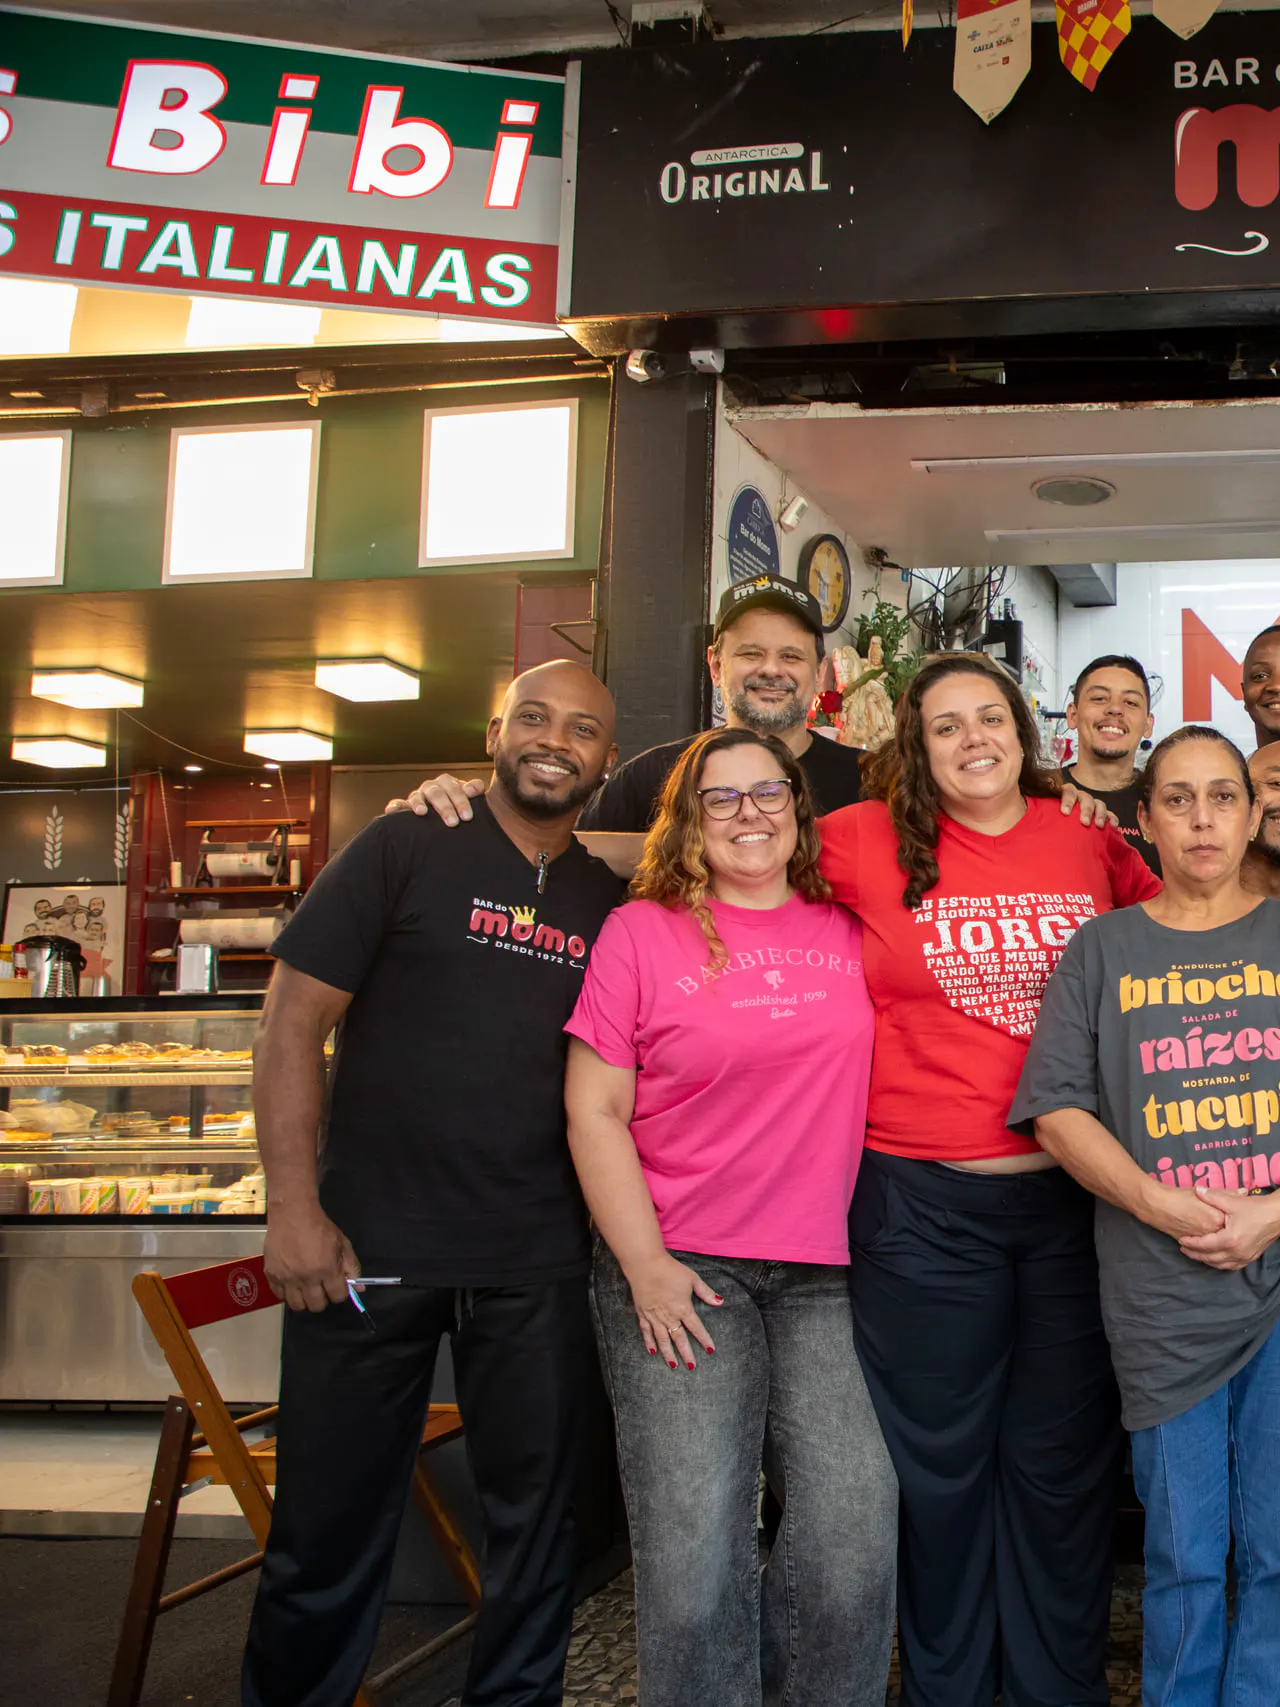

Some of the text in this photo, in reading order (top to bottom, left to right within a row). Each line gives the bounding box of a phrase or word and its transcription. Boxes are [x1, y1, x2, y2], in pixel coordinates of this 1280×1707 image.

[973, 42, 994, 53] CAIXA
[1174, 58, 1259, 88] BAR
[106, 59, 541, 209] Bibi
[705, 147, 789, 162] ANTARCTICA
[53, 208, 532, 307] ITALIANAS
[473, 898, 508, 912] BAR do
[938, 896, 992, 909] ESTOU
[995, 893, 1063, 907] VESTIDO
[1065, 893, 1095, 906] COM
[915, 903, 1098, 924] AS ROUPAS E AS ARMAS DE
[469, 908, 586, 958] momo
[495, 940, 564, 964] DESDE 1972
[926, 955, 966, 969] PARA
[970, 952, 1000, 965] QUE
[1005, 950, 1047, 962] MEUS
[932, 966, 976, 979] TENDO
[1033, 962, 1050, 971] ME
[938, 976, 979, 988] TENDO
[944, 986, 983, 997] TENDO
[985, 983, 1022, 993] OLHOS
[731, 991, 827, 1009] established 1959
[950, 998, 959, 1008] E
[961, 994, 989, 1007] NEM
[992, 991, 1010, 1003] EM
[1182, 1009, 1239, 1024] SALADA DE
[1182, 1073, 1251, 1088] MOSTARDA DE
[1194, 1139, 1238, 1151] BARRIGA
